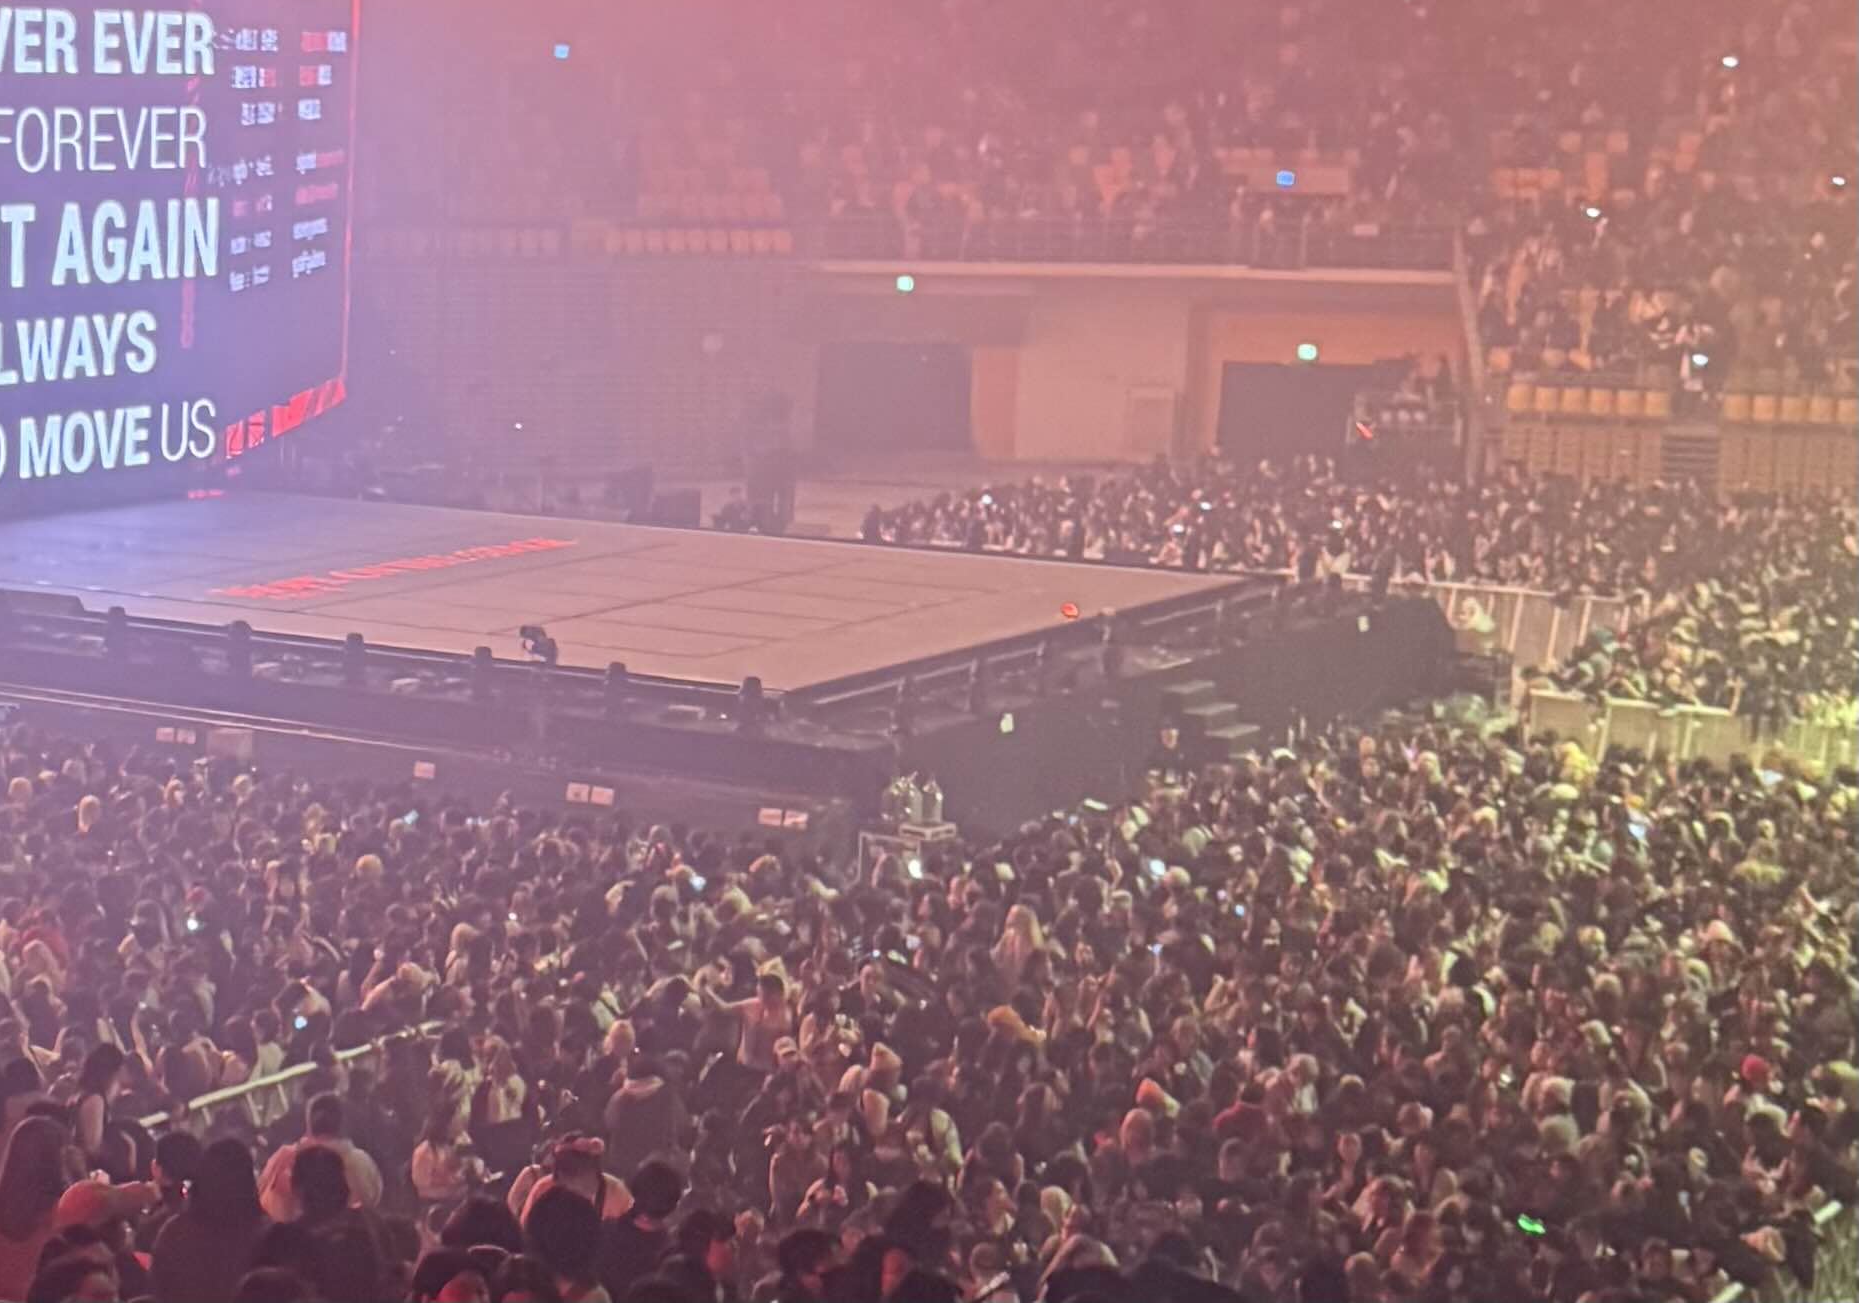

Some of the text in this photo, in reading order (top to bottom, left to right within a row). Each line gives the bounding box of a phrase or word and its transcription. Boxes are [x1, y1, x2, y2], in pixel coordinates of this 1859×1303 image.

[94, 10, 215, 75] EVER
[52, 197, 219, 286] AGAIN
[20, 407, 150, 478] MOVE
[161, 399, 217, 461] US
